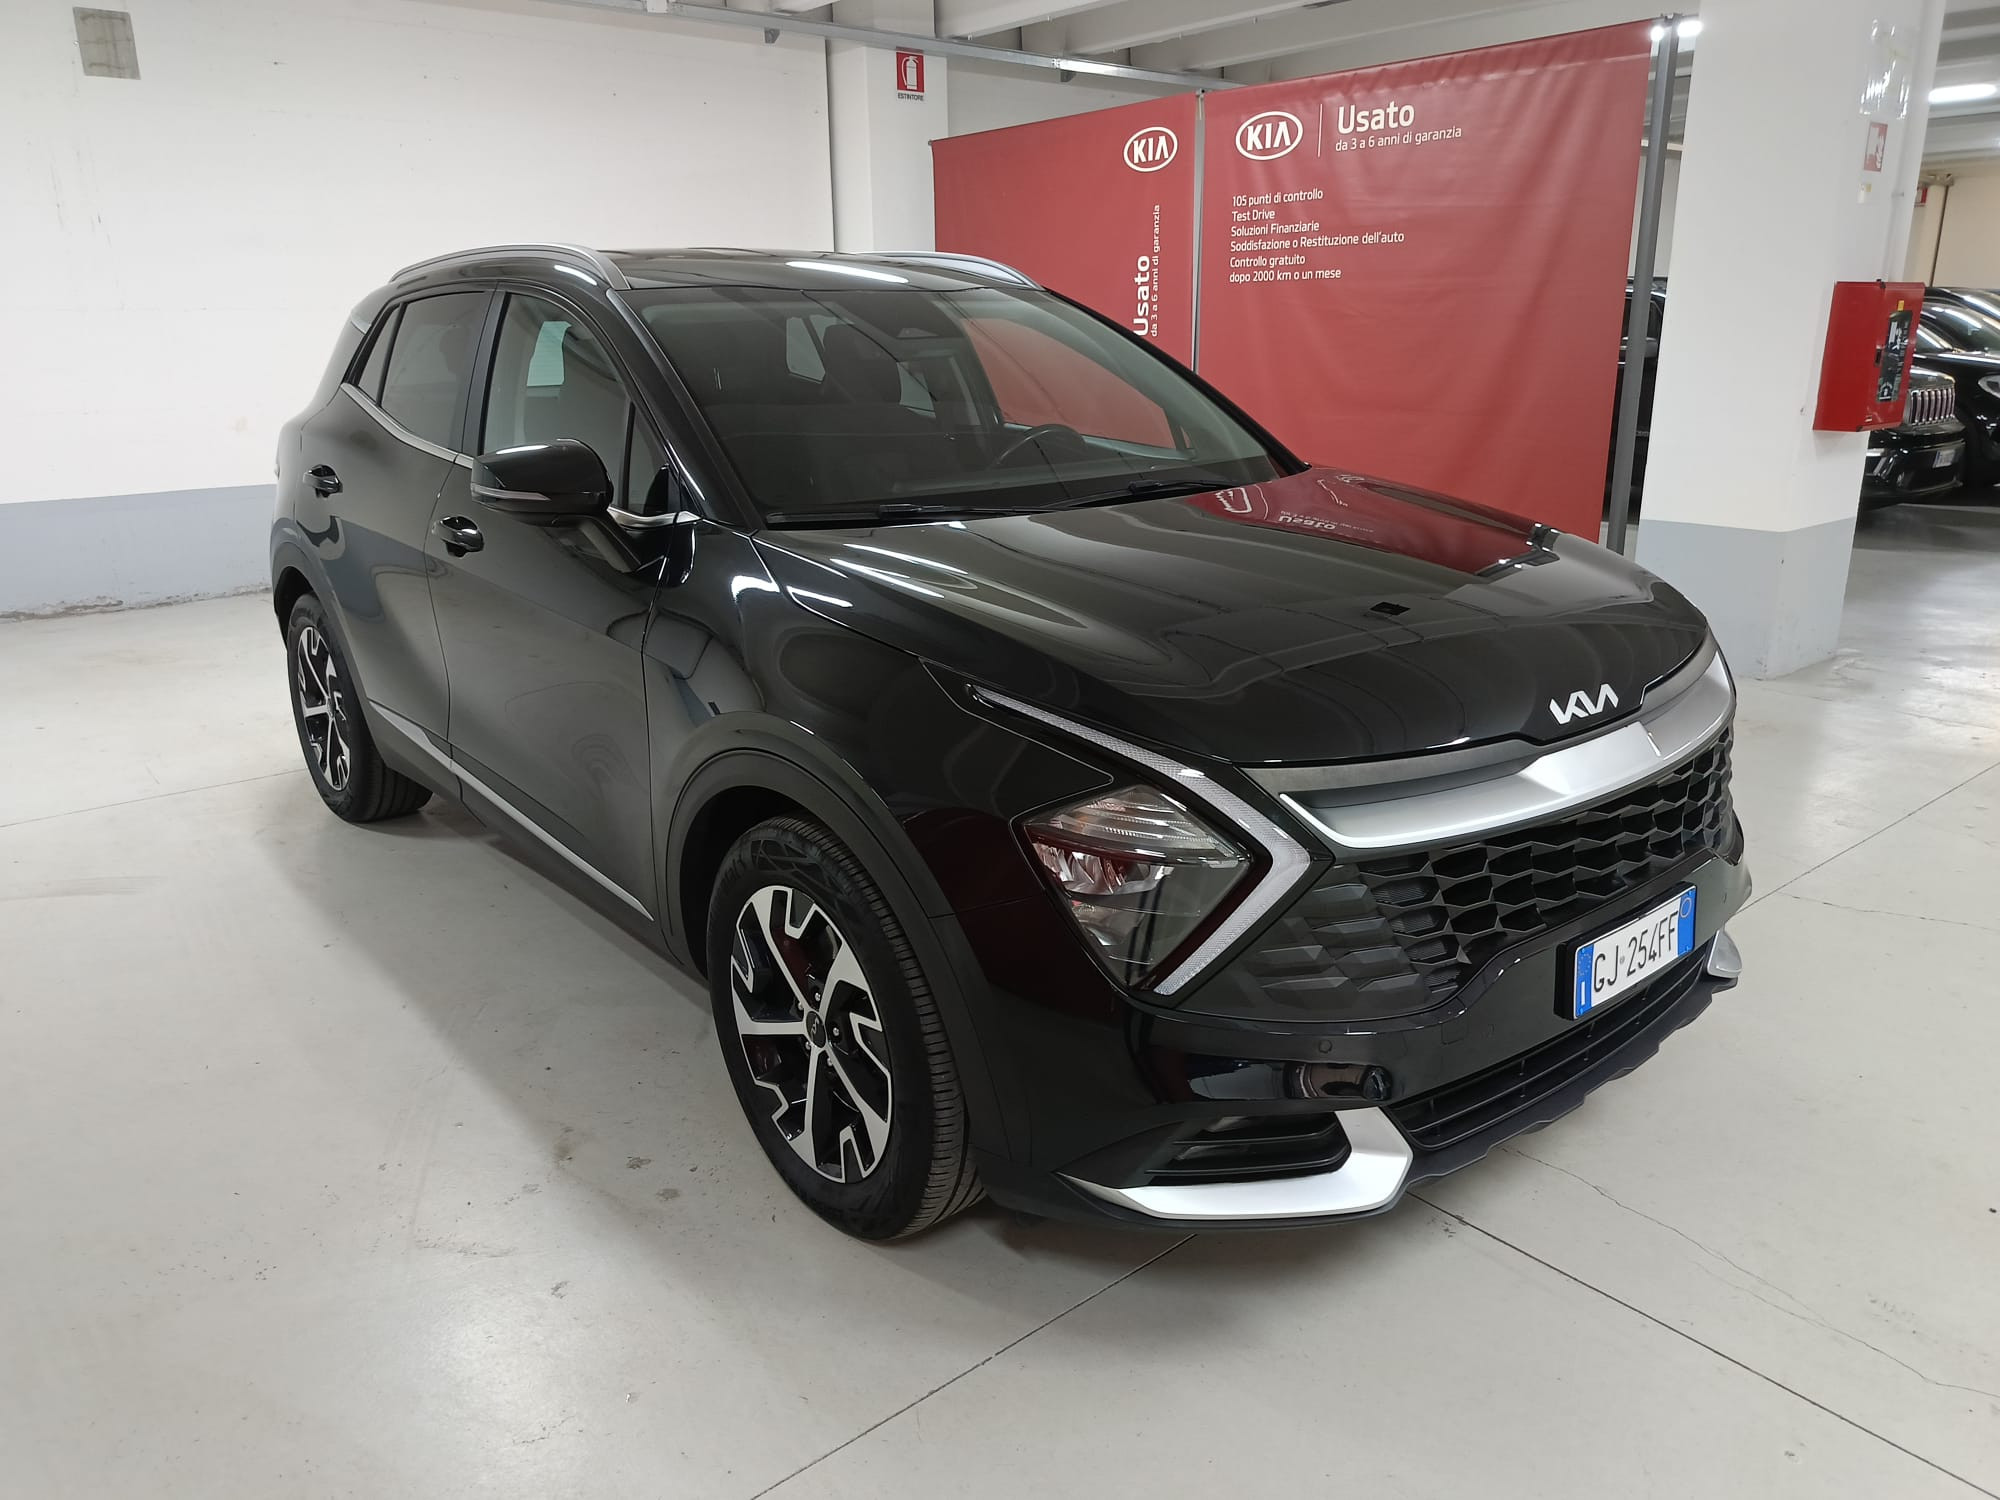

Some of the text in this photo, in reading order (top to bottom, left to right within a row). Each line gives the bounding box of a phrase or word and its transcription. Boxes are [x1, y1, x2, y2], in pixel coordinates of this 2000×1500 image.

[1337, 101, 1415, 134] Usato
[1246, 121, 1291, 151] KIA
[1335, 126, 1462, 152] da 3 a 6 anni di garanzia
[1133, 136, 1169, 163] KIA
[1232, 189, 1323, 207] 105 punti di controllo
[1232, 209, 1275, 222] Test Drive
[1231, 221, 1320, 237] Soluzioni Finanziarie
[1230, 238, 1290, 252] Soddisfazione
[1293, 240, 1297, 249] o
[1300, 234, 1359, 248] Restituzione
[1152, 255, 1159, 265] di
[1230, 255, 1305, 269] Controllo gratuito
[1229, 269, 1341, 284] dopo 2000 km o un mese
[1134, 255, 1150, 336] Usato
[1151, 323, 1158, 337] da
